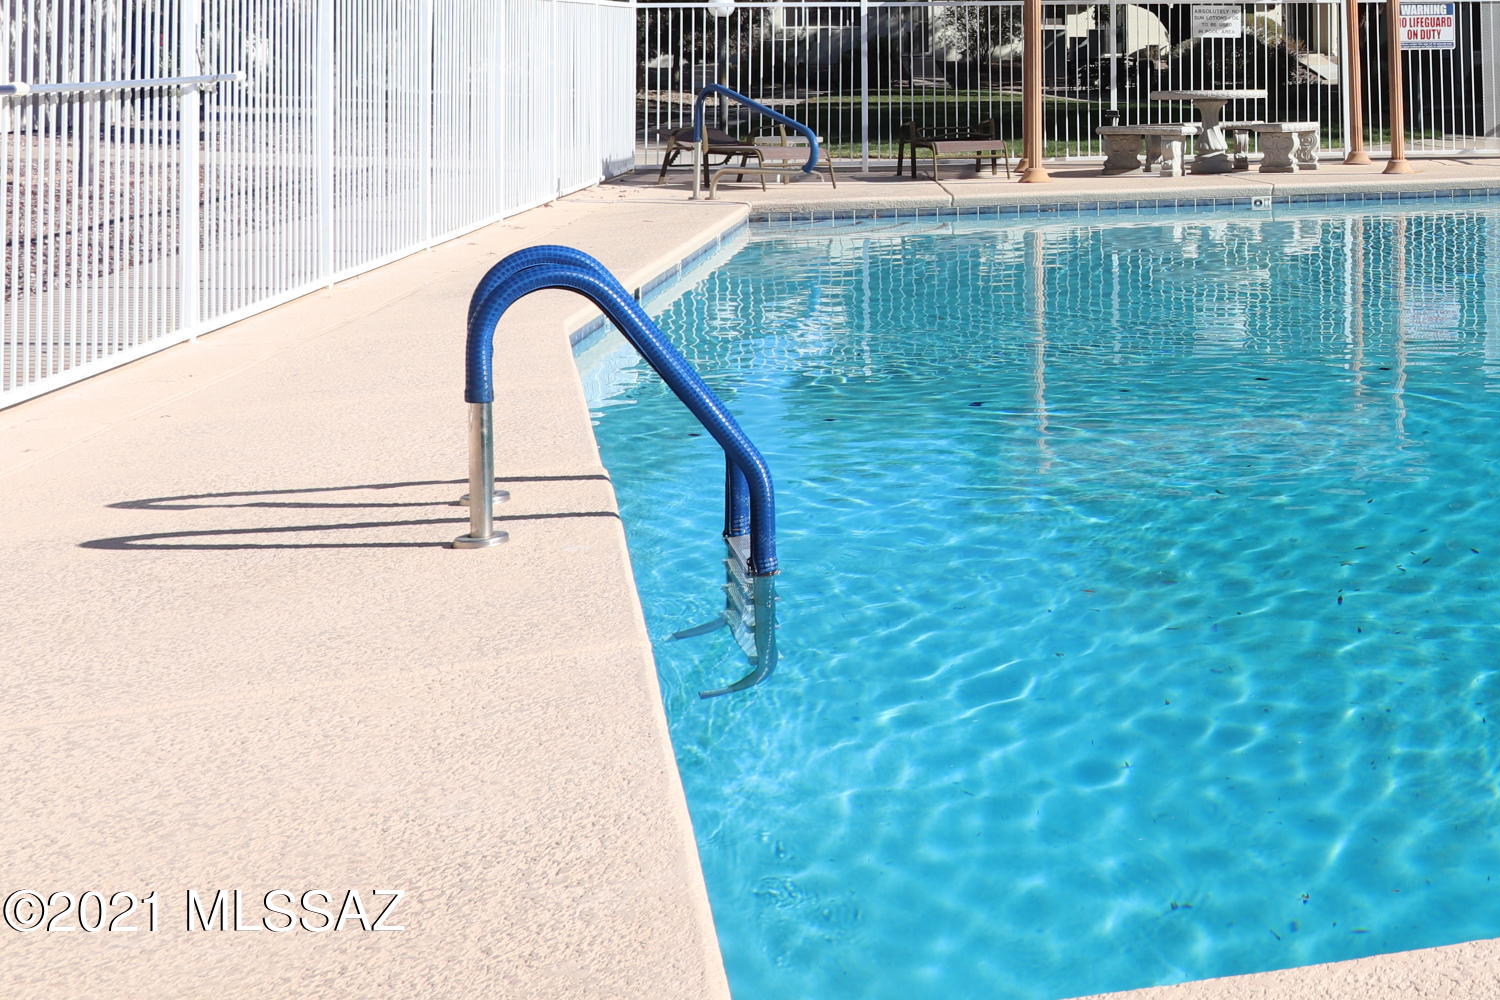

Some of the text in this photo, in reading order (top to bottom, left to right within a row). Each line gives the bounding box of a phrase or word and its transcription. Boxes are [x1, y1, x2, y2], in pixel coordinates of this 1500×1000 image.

[1400, 4, 1447, 15] WARNING
[1409, 17, 1452, 28] LIFEGUARD
[1407, 29, 1442, 40] ON DUTY
